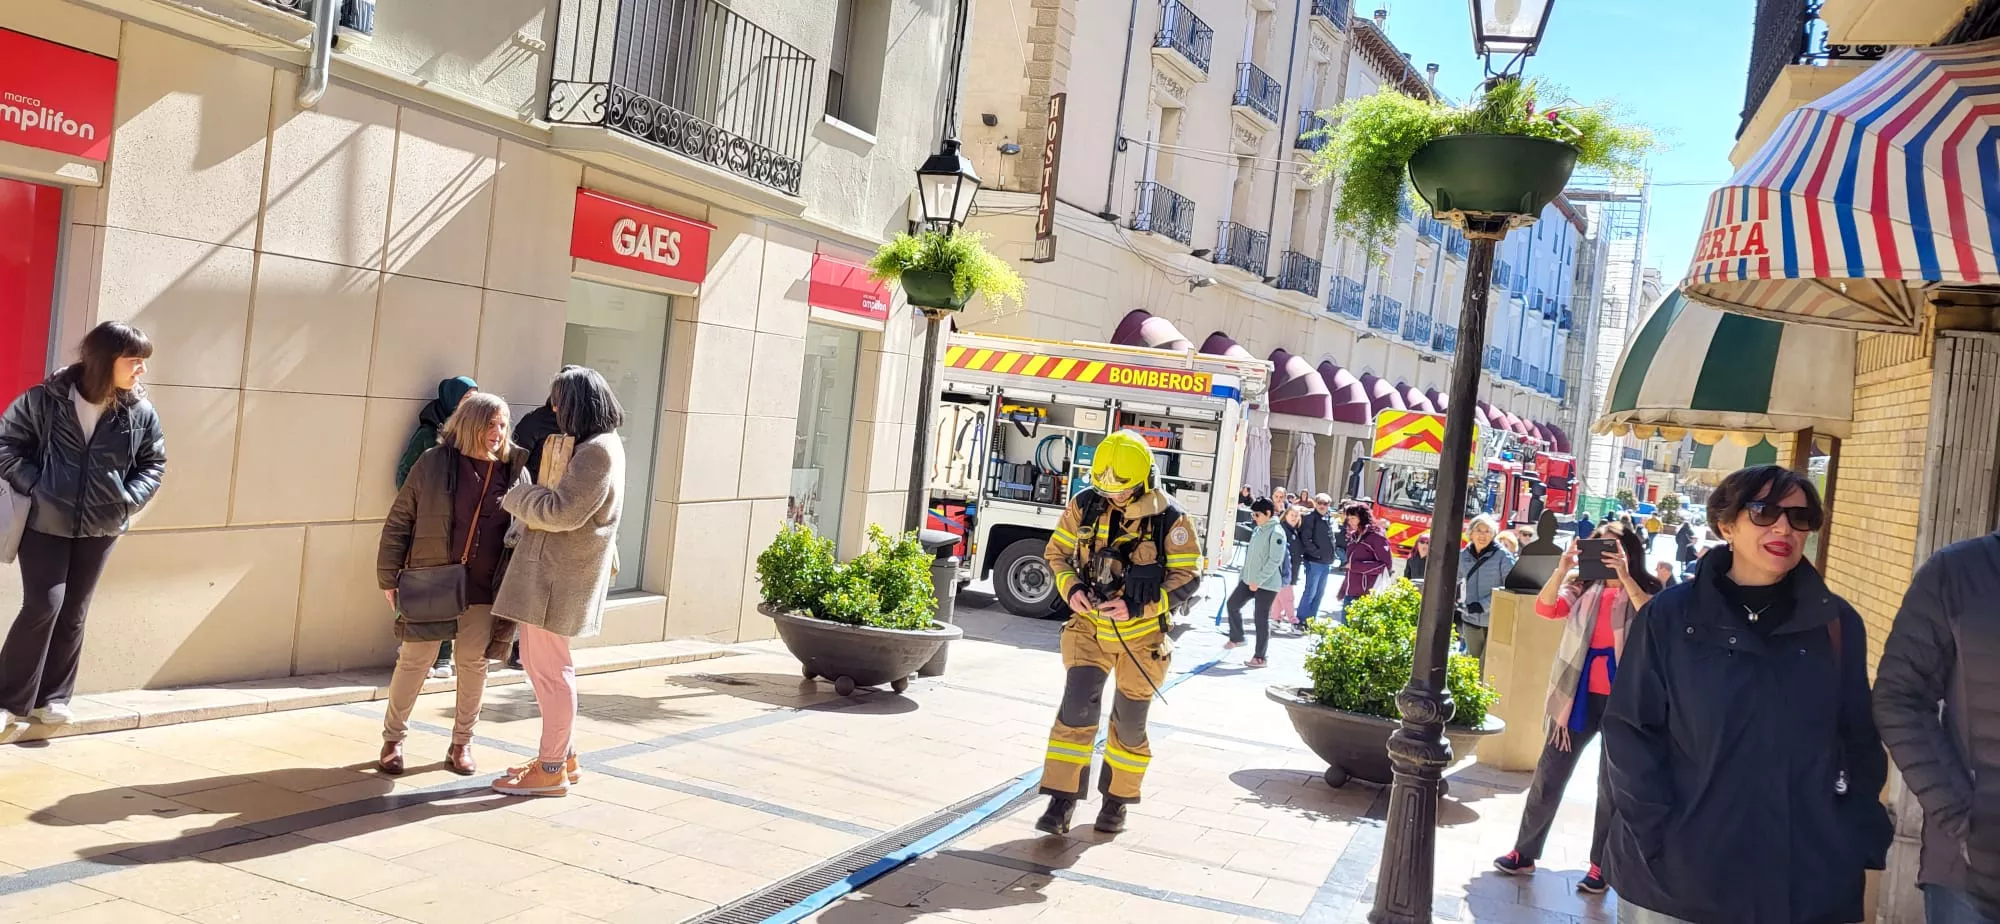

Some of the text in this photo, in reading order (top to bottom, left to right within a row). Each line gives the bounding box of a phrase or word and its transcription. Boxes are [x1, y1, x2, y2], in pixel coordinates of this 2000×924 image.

[4, 92, 41, 107] marca
[1038, 97, 1060, 234] HOSTAL
[612, 218, 681, 267] GAES
[1696, 222, 1769, 262] ERIA
[1109, 367, 1205, 393] BOMBEROS
[1401, 513, 1428, 523] IVECO
